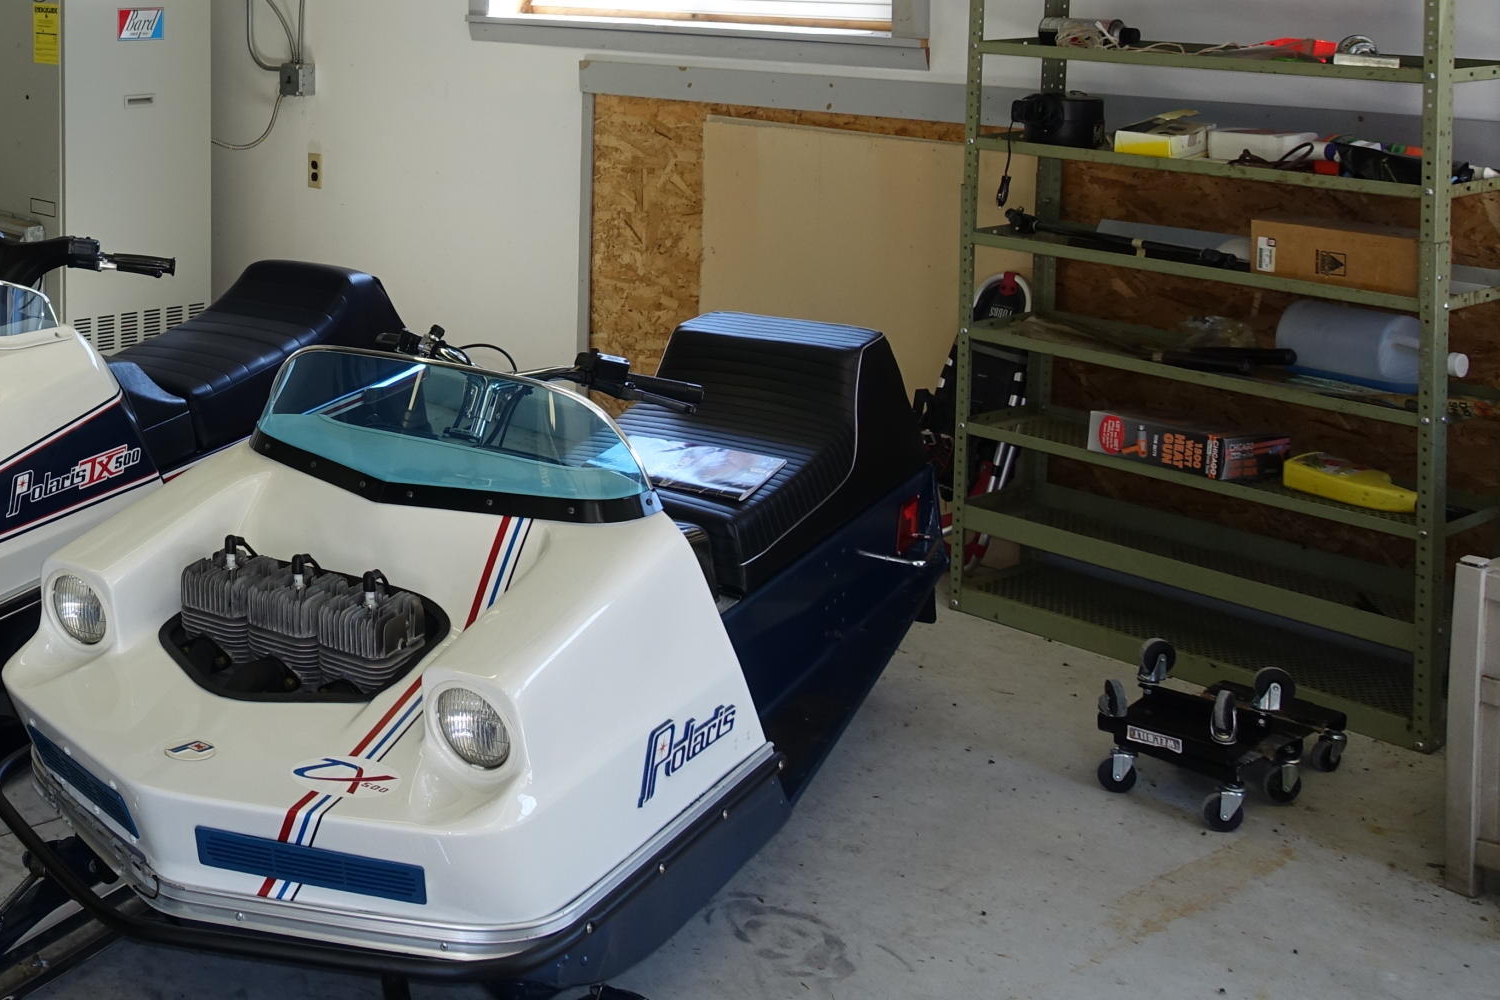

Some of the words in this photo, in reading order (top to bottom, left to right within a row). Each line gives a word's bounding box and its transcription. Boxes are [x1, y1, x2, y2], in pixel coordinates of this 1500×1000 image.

[1161, 433, 1174, 465] GUN
[1173, 433, 1186, 469] HEAT
[6, 466, 87, 518] Polaris
[637, 704, 736, 808] Polaris
